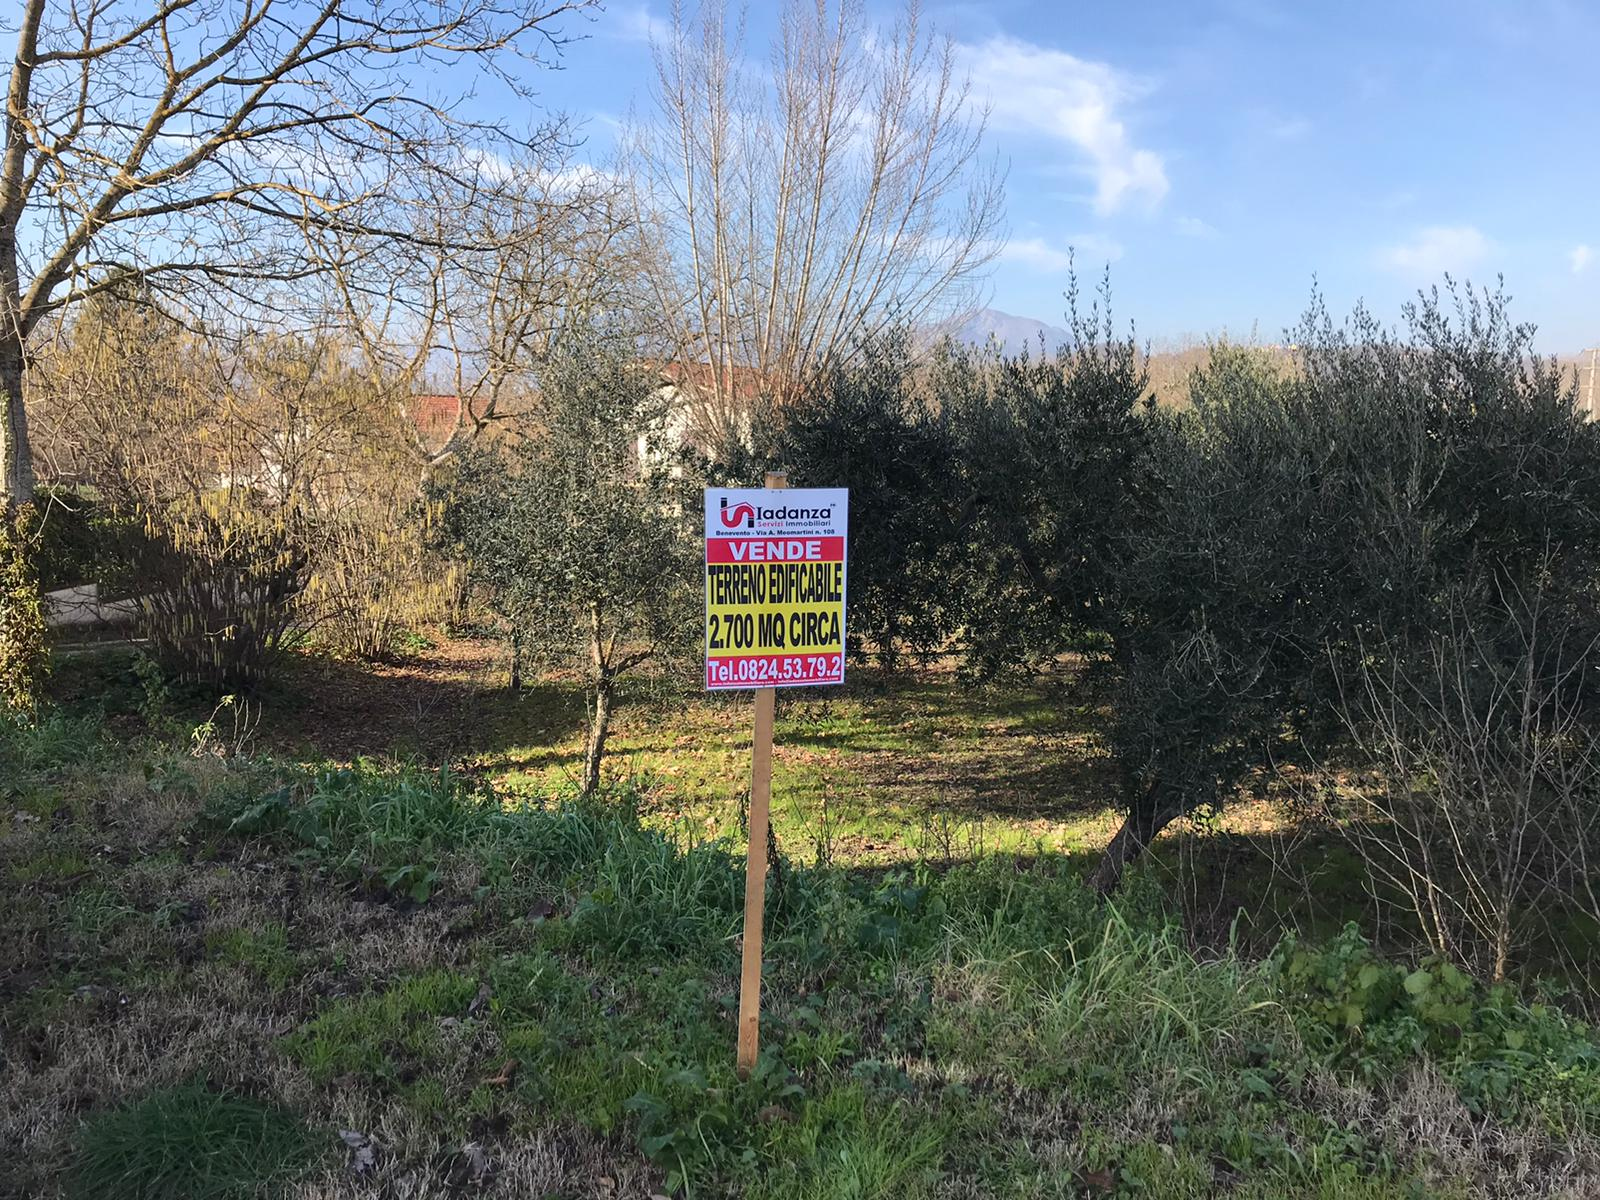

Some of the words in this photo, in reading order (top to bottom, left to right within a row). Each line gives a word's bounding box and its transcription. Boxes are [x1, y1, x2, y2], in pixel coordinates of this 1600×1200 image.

[756, 506, 831, 520] Iadanza
[728, 541, 822, 561] VENDE
[707, 563, 766, 605] TERRENO
[769, 562, 842, 604] EDIFICABILE
[709, 613, 754, 649] 2.700
[758, 612, 785, 650] MQ
[789, 611, 841, 647] CIRCA
[708, 655, 841, 682] Tel.0824.53.79.2
